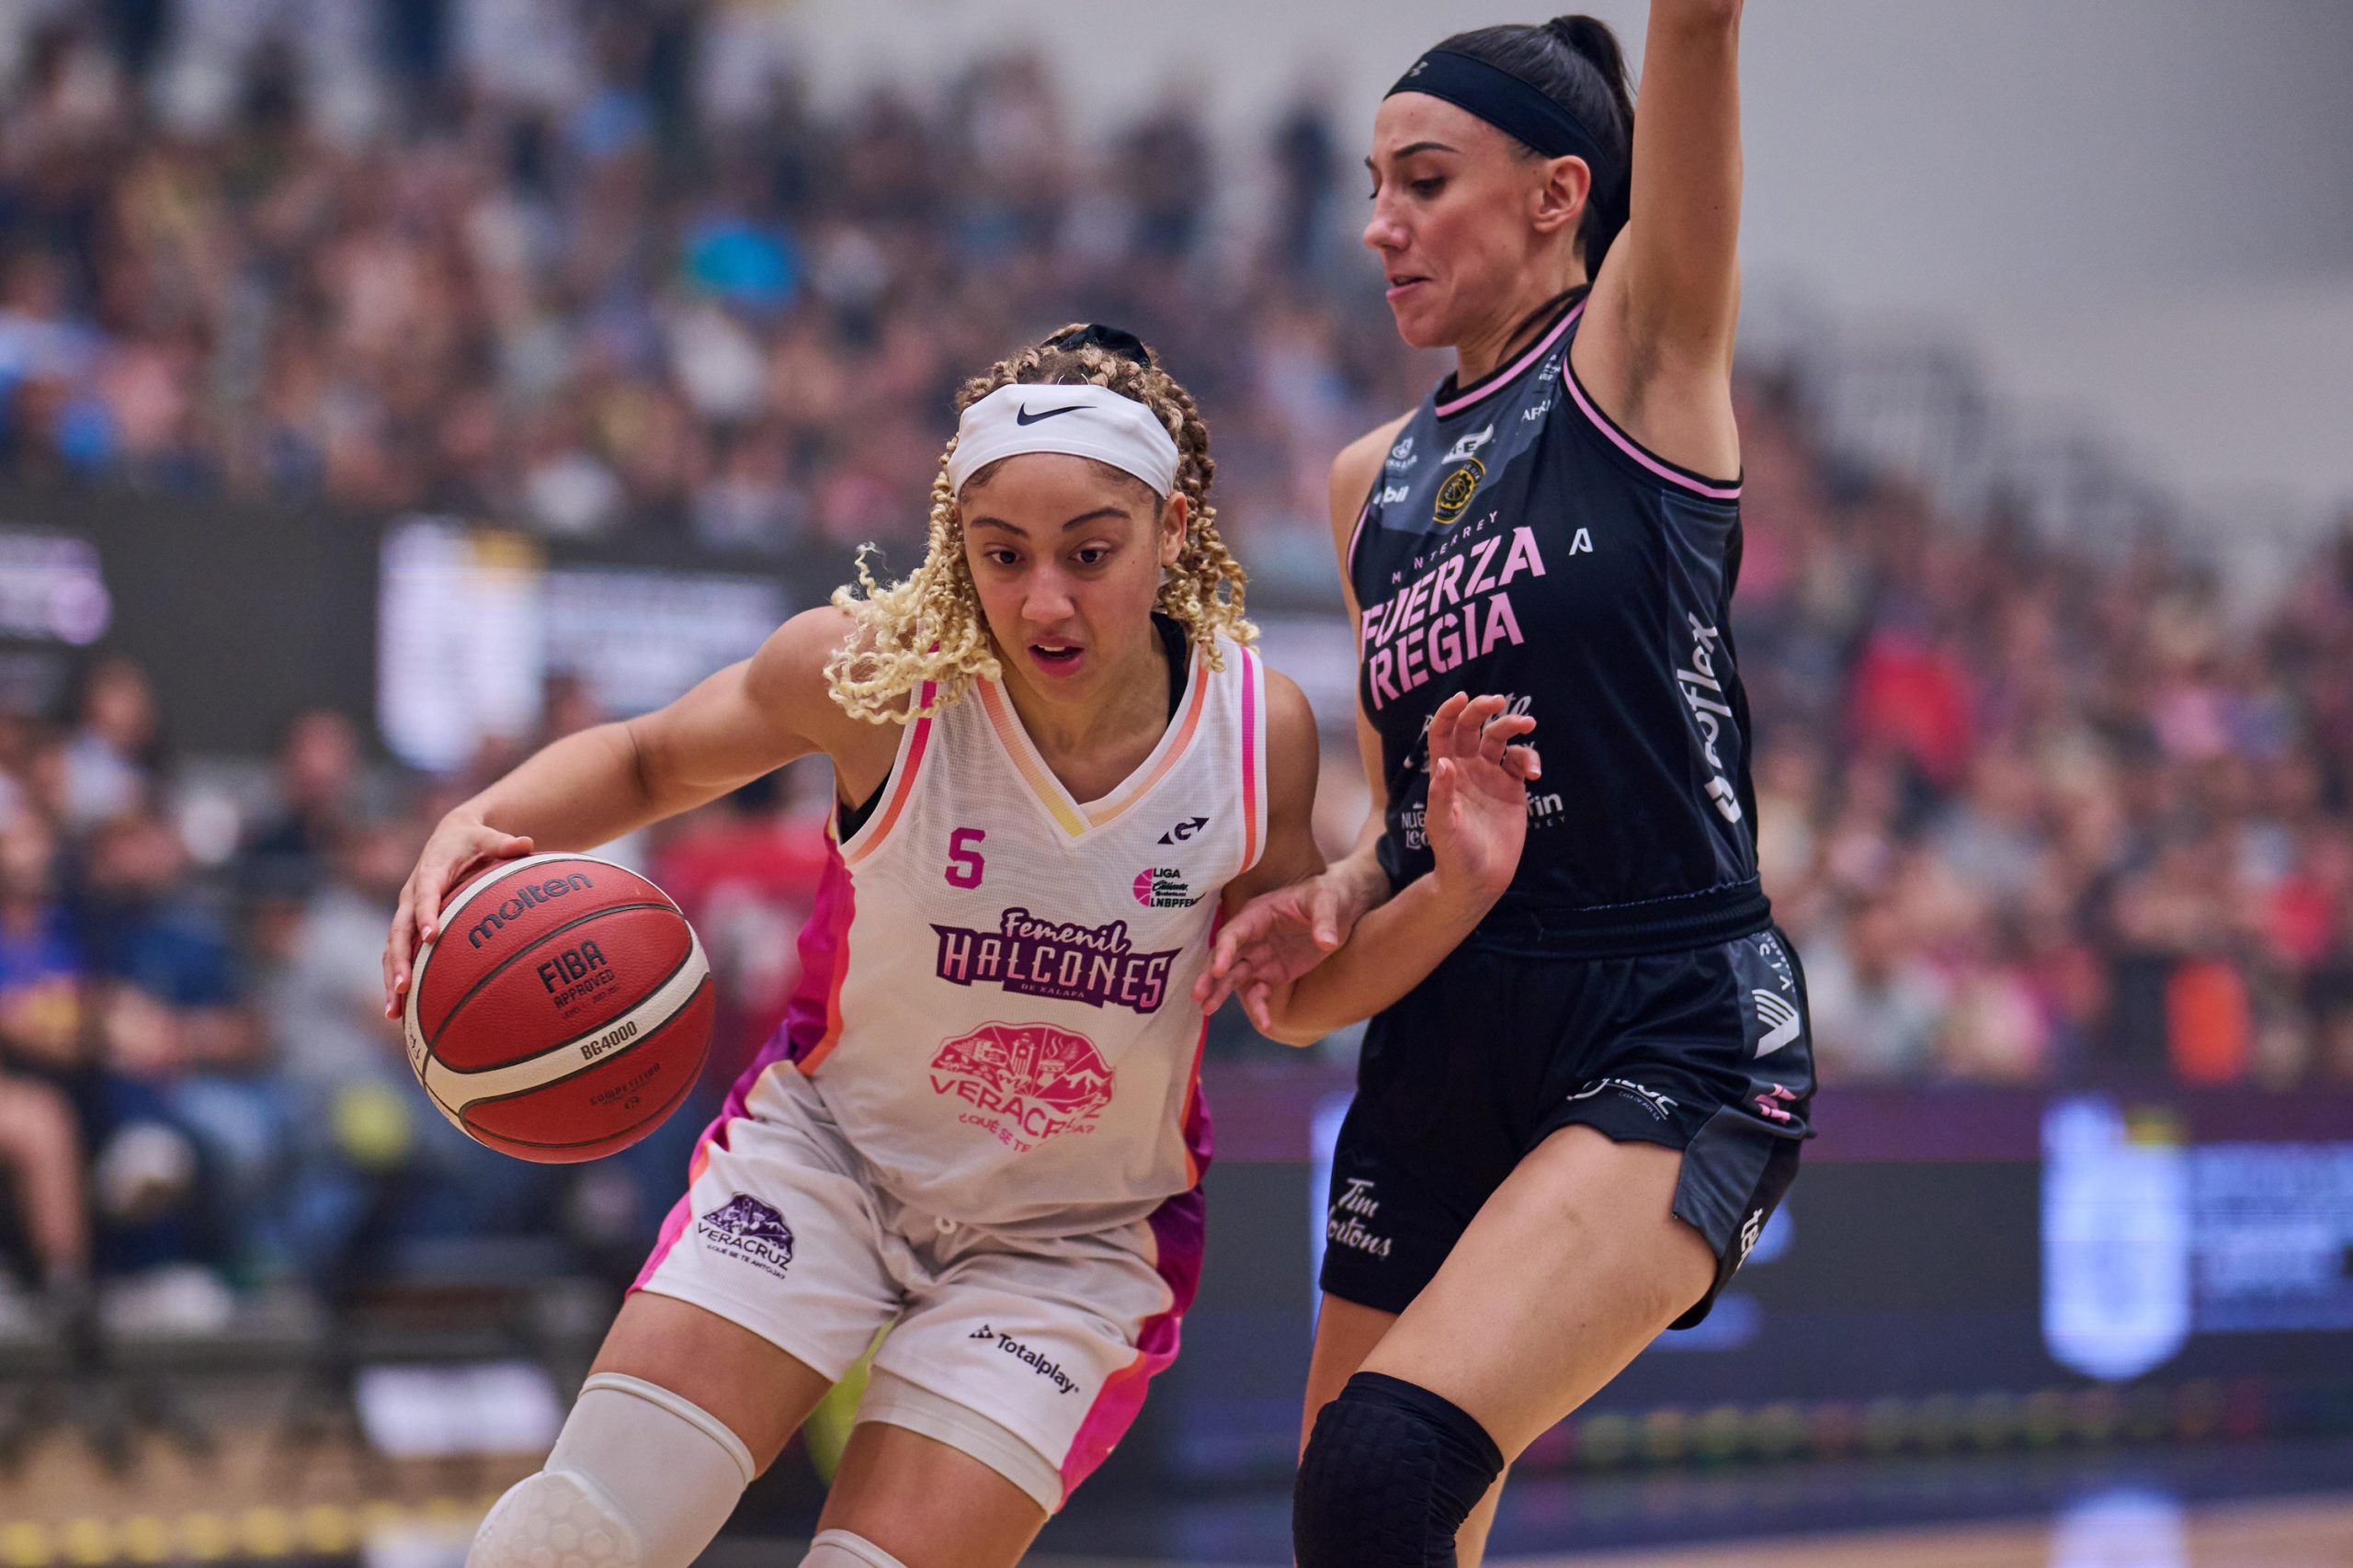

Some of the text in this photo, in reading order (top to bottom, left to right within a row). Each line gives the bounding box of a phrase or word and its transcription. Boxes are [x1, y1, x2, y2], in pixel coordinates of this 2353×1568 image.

[1392, 511, 1498, 585] MNTERREY
[1361, 526, 1546, 663] FUERZA
[1369, 592, 1525, 710] REGIA
[1402, 811, 1427, 829] NUE
[944, 826, 986, 890] 5
[1153, 868, 1181, 879] LIGA
[468, 873, 594, 949] molten
[1006, 912, 1128, 954] Femenil
[537, 940, 608, 994] FIBA
[553, 969, 616, 1009] APPROVED
[943, 932, 1170, 1007] HALCONES
[1021, 983, 1035, 992] DE
[580, 1020, 638, 1061] BG4000
[929, 1074, 1100, 1139] VERACRZ
[959, 1113, 1031, 1153] ¿QUÉ SE TE
[1337, 1177, 1380, 1218] Tim
[699, 1222, 791, 1271] VERACRUZ
[1327, 1205, 1392, 1257] ortons
[997, 1333, 1076, 1394] Totalplay
